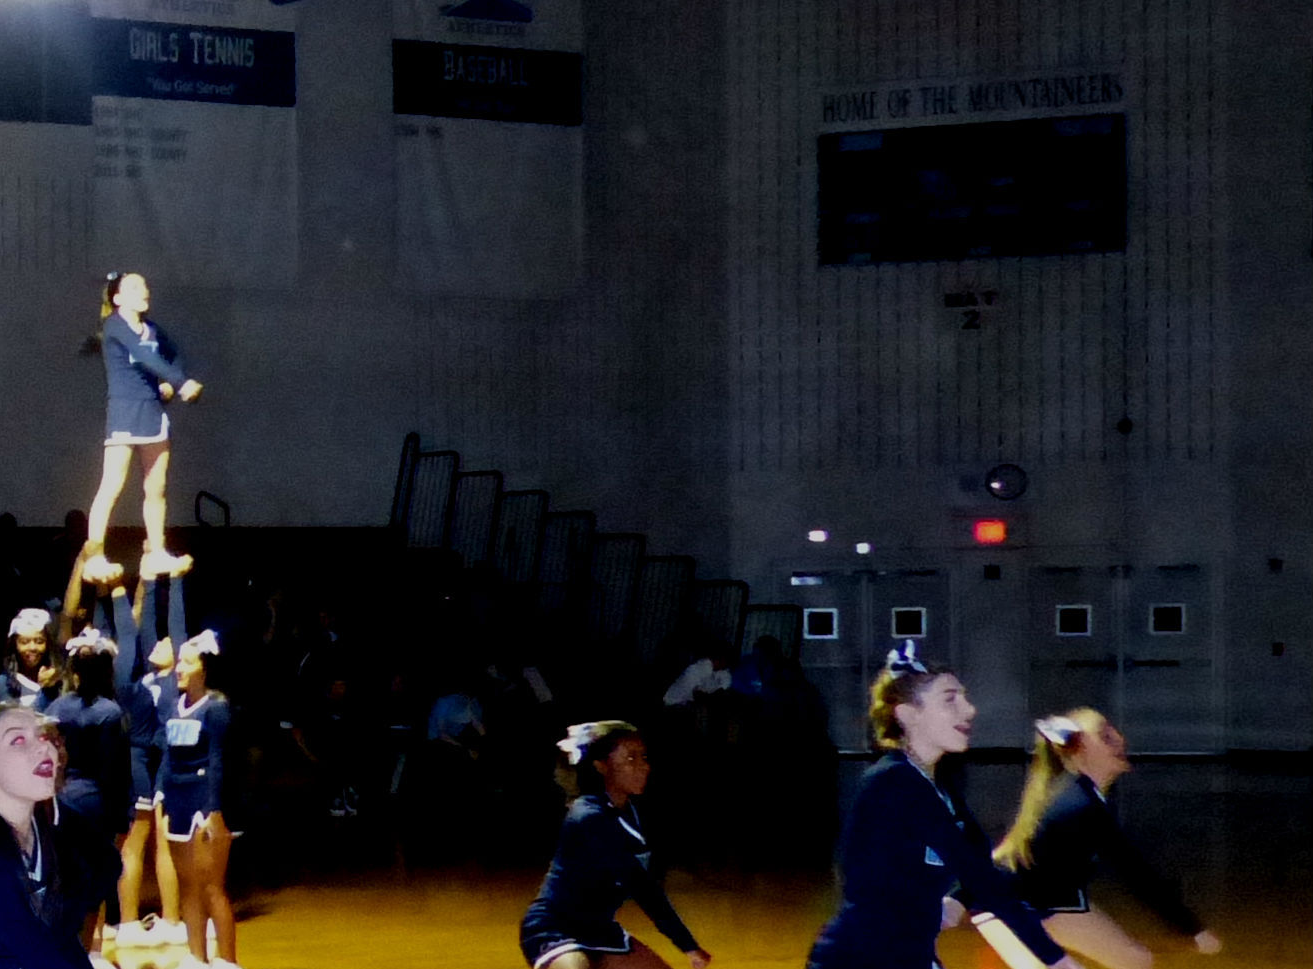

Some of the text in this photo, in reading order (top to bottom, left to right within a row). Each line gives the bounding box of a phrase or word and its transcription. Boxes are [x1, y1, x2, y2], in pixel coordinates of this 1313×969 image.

[128, 28, 255, 67] GIRLS TENNIS
[443, 50, 529, 86] BASEBALL
[821, 73, 1124, 124] HOME OF THE MOUNTAINEERS
